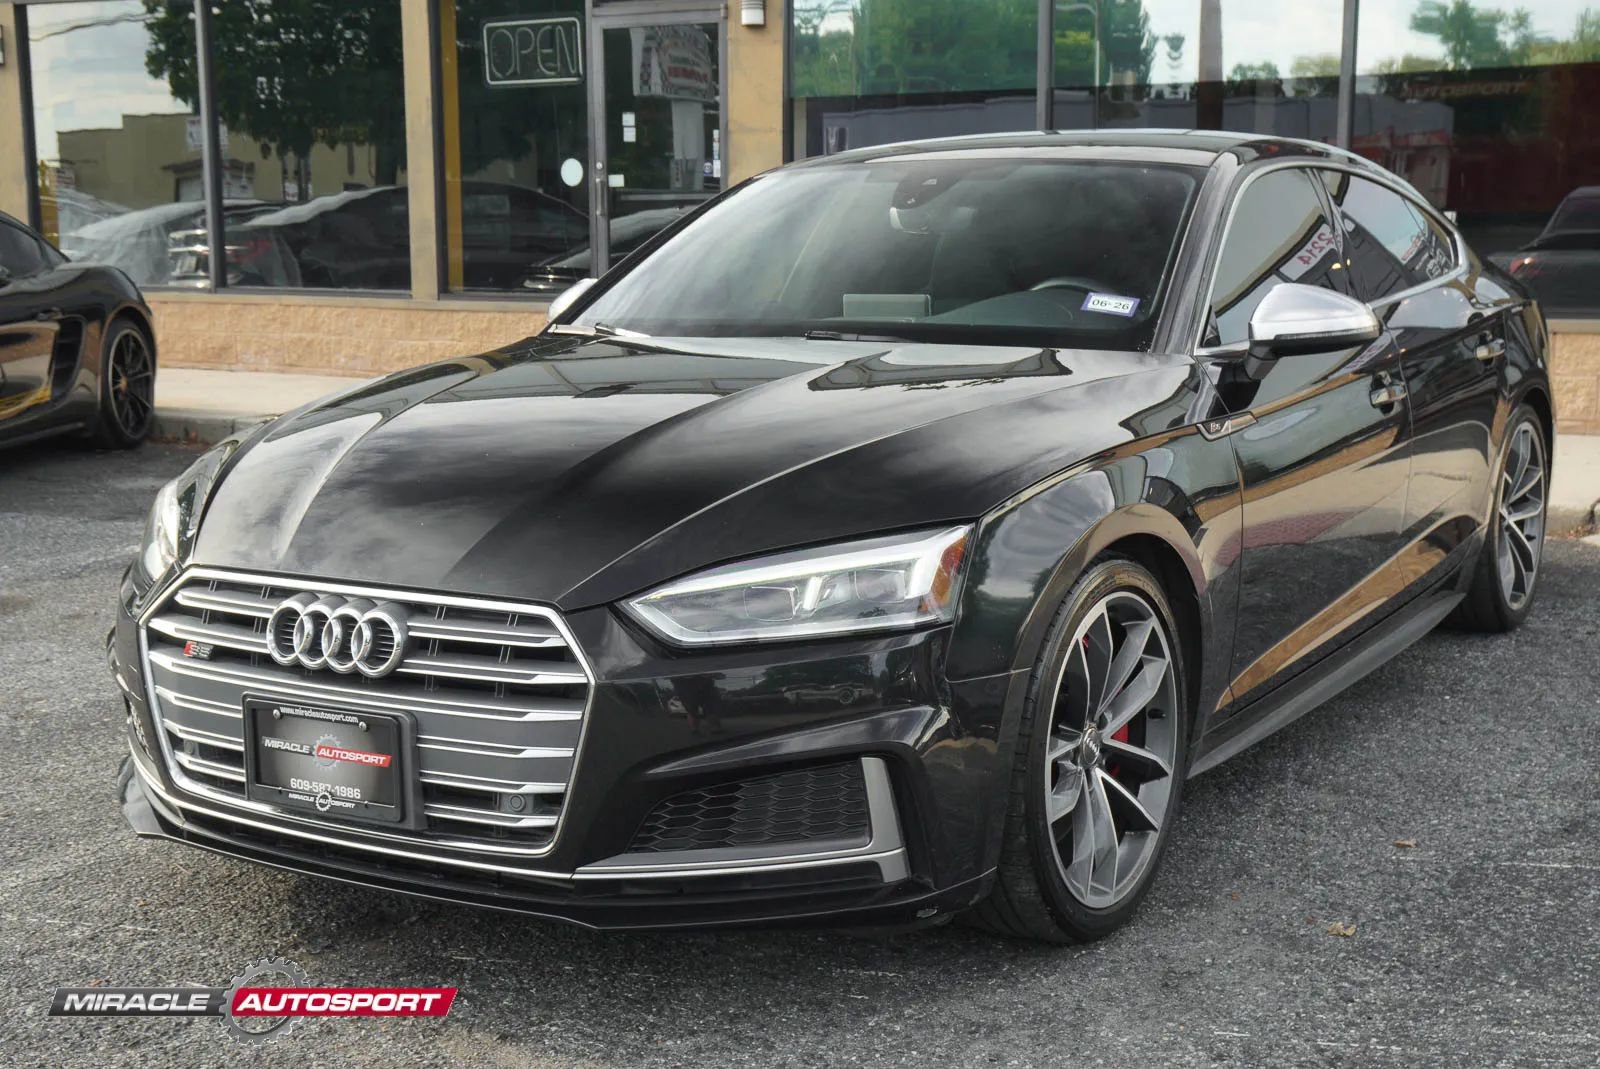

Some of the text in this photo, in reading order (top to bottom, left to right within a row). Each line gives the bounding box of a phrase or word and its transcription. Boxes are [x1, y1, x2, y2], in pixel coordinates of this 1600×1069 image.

[490, 25, 577, 79] OPEN
[264, 739, 387, 765] MIRACLE AUTOSPORT
[290, 778, 361, 799] 609-587-1986
